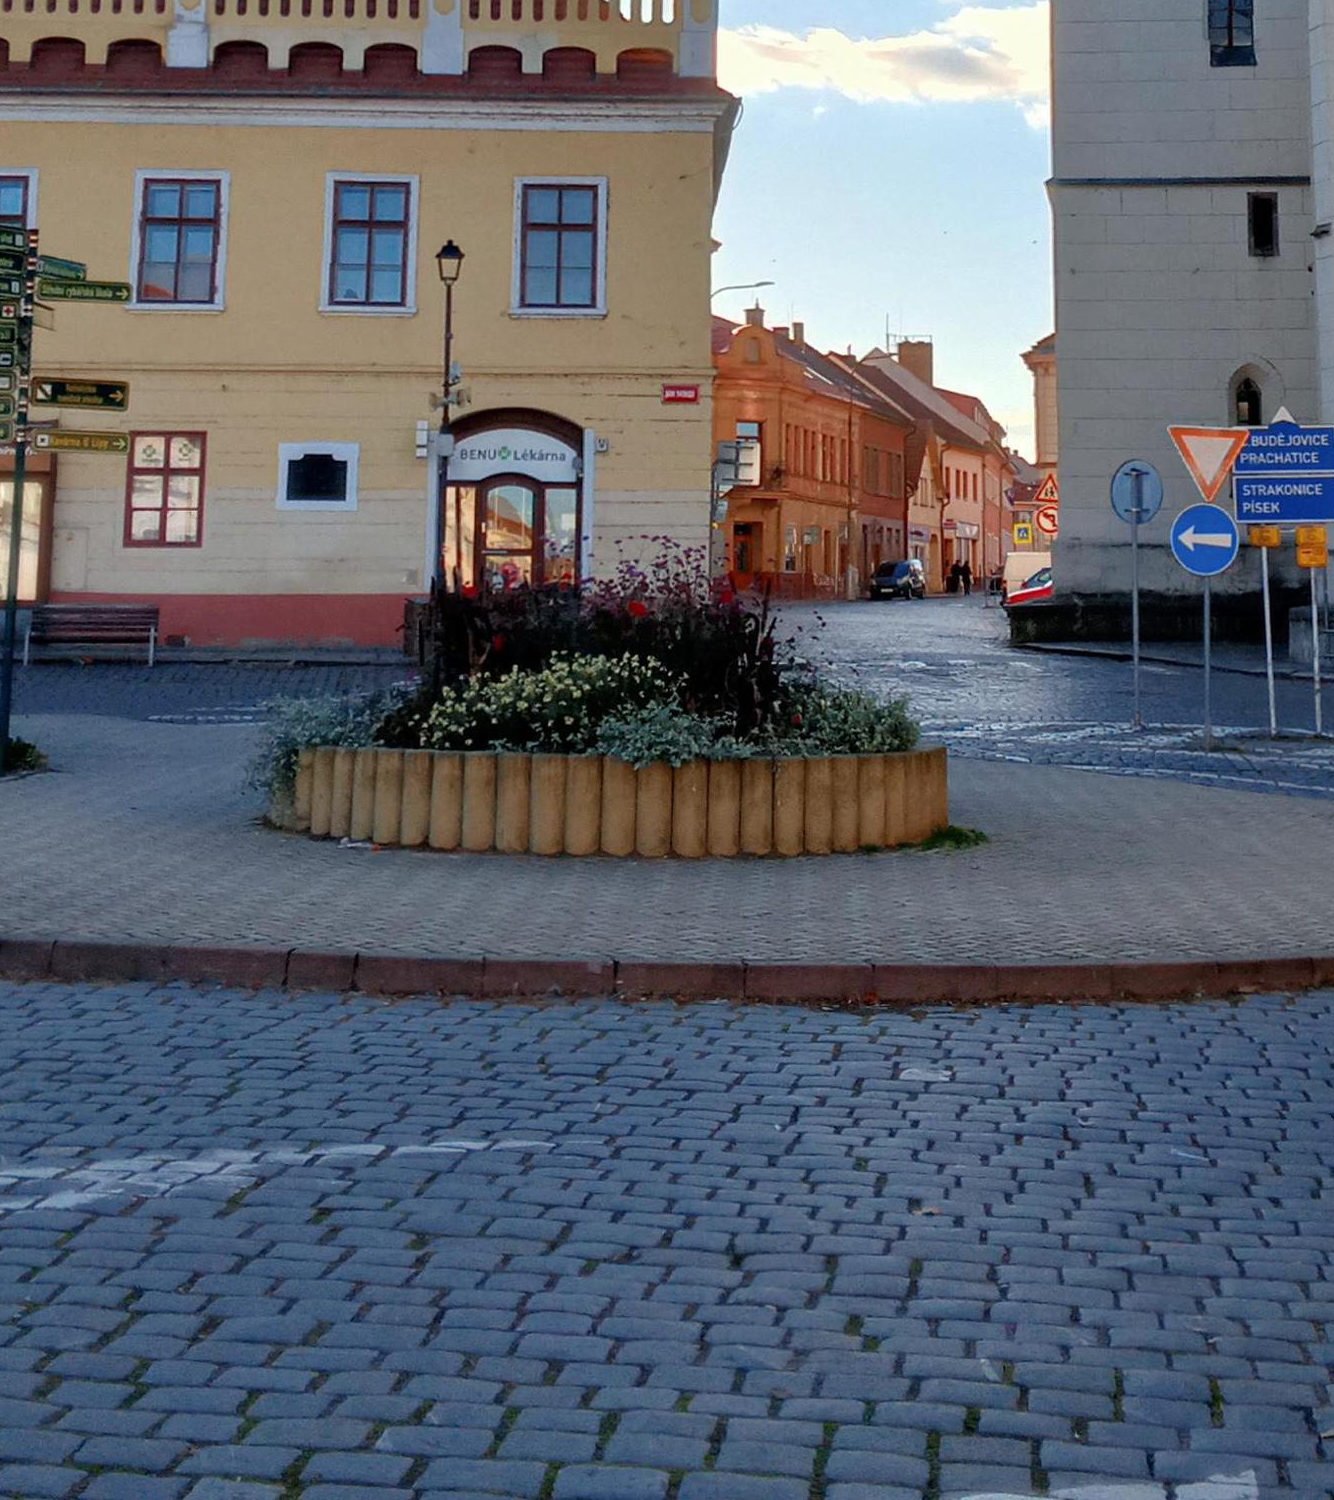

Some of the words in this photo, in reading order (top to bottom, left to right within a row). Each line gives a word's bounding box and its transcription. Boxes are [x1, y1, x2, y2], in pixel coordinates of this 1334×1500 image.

[1251, 432, 1329, 447] BUDĚJOVICE
[460, 449, 497, 461] BENU
[513, 447, 566, 462] Lékárna
[1240, 451, 1320, 465] PRACHATICE
[1242, 483, 1323, 497] STRAKONICE
[1242, 499, 1280, 514] PÍSEK
